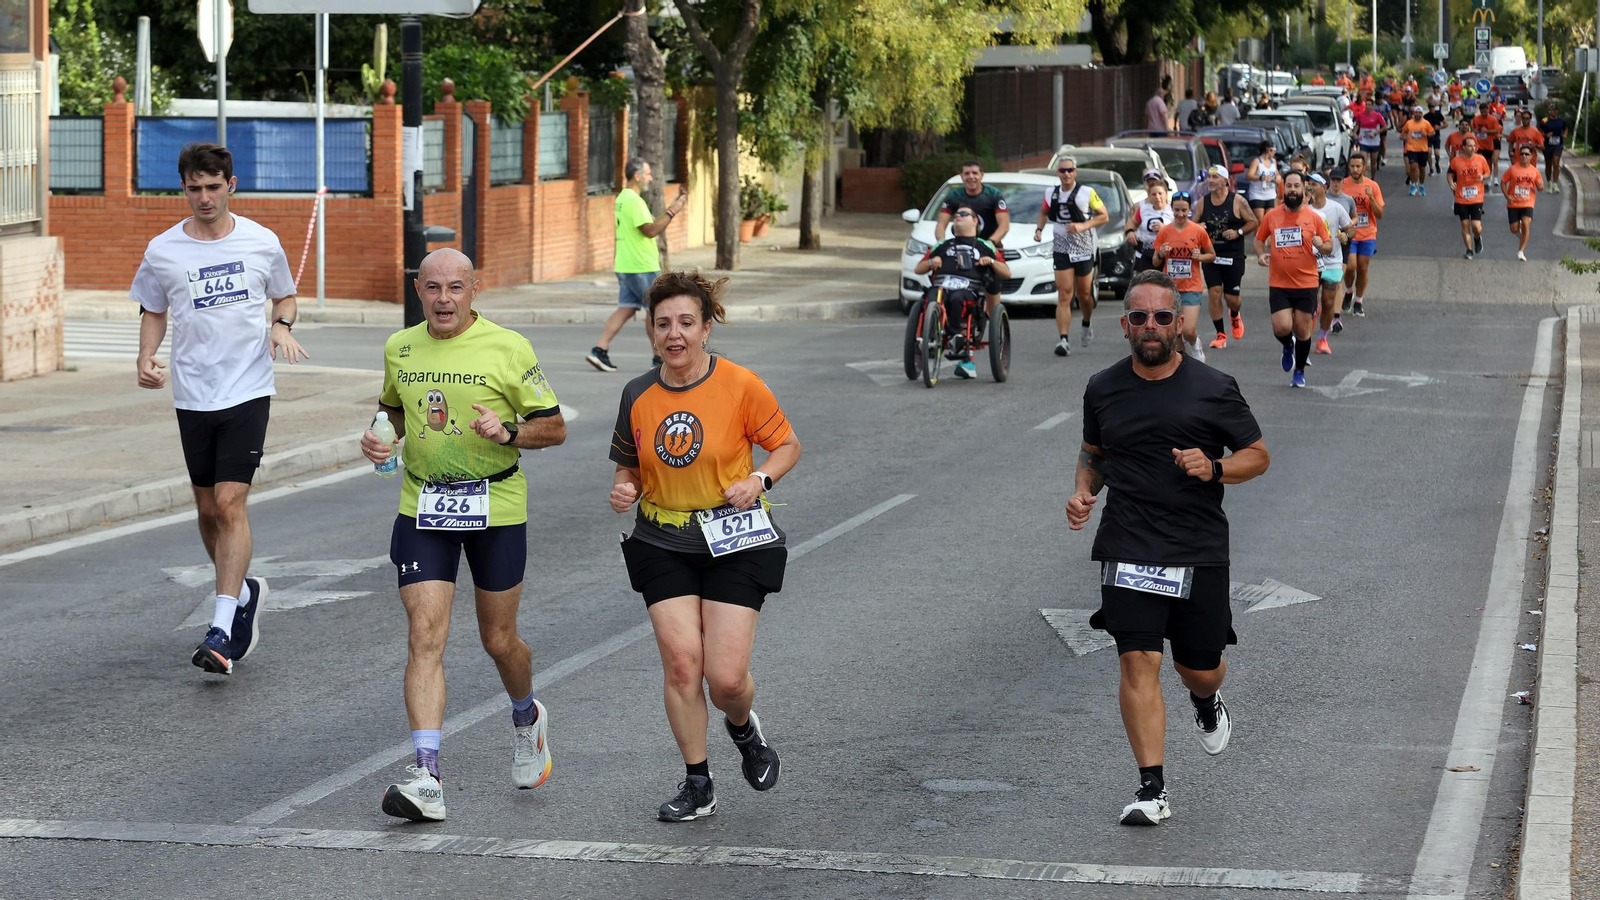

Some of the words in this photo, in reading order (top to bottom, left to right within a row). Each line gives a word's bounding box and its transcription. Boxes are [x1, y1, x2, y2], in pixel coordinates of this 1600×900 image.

[204, 277, 234, 294] 646
[397, 369, 488, 387] Paparunners
[665, 412, 695, 427] BEER
[656, 442, 701, 467] RUNNERS
[434, 496, 471, 514] 626
[721, 512, 754, 536] 627
